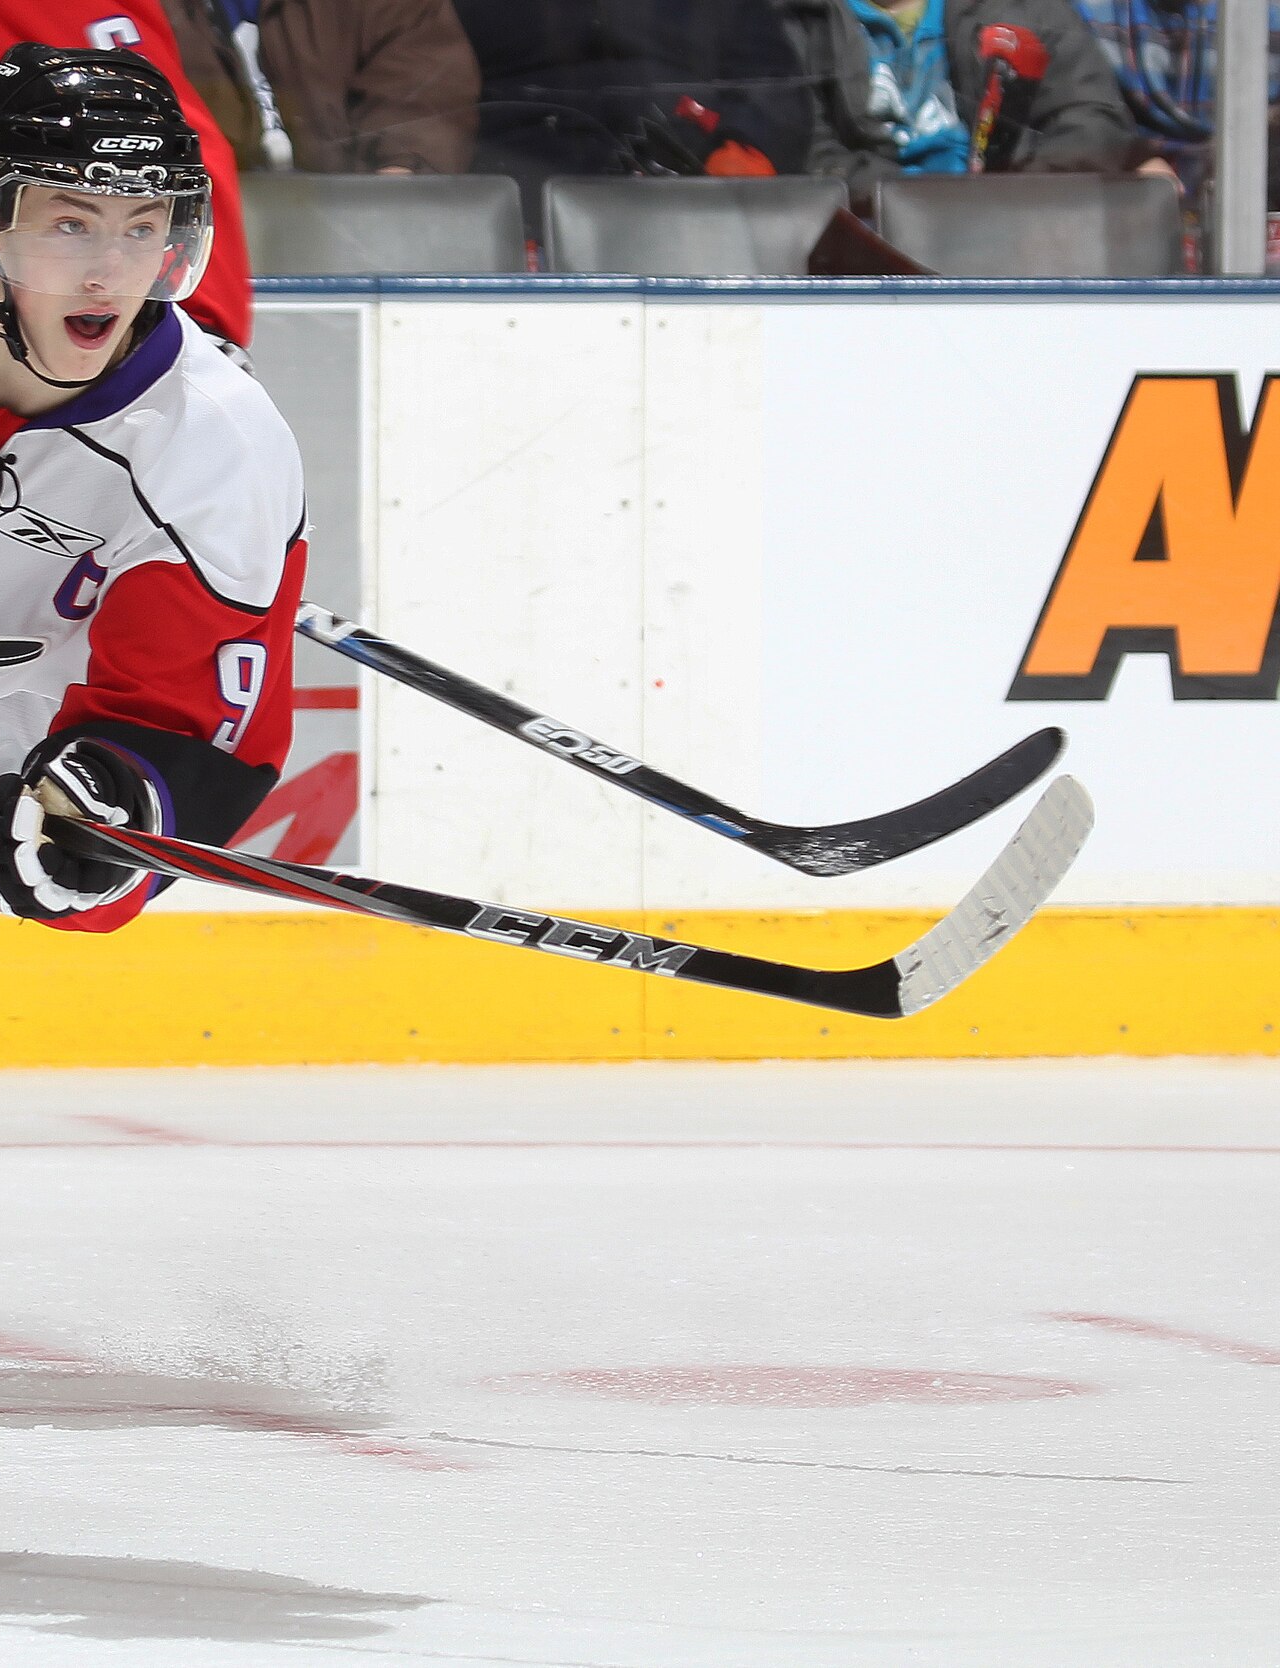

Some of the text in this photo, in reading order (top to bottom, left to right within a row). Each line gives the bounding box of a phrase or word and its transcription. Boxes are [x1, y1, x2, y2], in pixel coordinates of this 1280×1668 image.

[101, 137, 159, 152] CCM
[1005, 374, 1280, 702] A
[53, 551, 108, 620] C
[211, 639, 267, 755] 9
[465, 899, 698, 977] CCM
